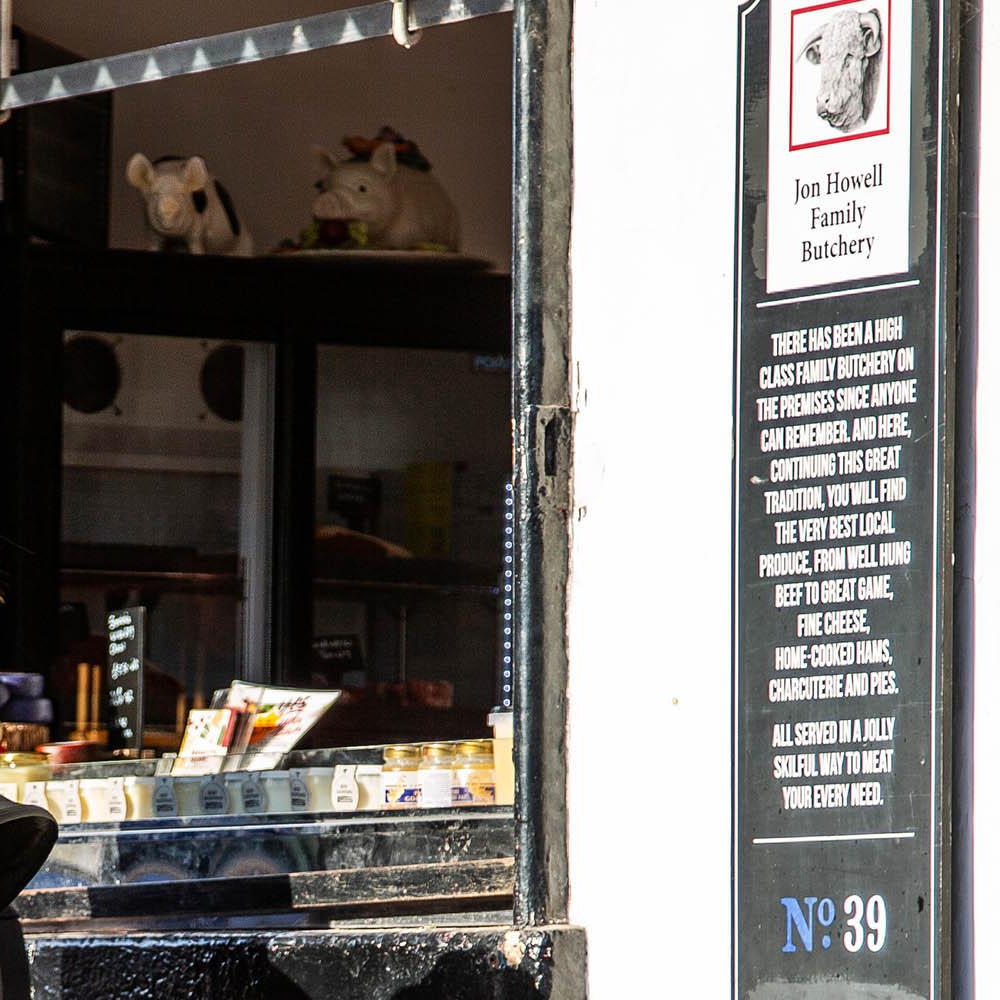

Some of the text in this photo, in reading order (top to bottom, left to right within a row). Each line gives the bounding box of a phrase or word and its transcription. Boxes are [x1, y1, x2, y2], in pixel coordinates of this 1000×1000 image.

[794, 163, 883, 205] Jon Howell
[810, 200, 866, 230] Family
[801, 234, 875, 263] Butchery
[771, 316, 902, 356] THERE HAS BEEN A HIGH
[760, 347, 914, 389] CLASS FAMILY BUTCHERY ON
[757, 380, 917, 421] THE PREMISES SINCE ANYONE
[761, 413, 911, 452] CAN REMEMBER. AND HERE,
[771, 446, 901, 482] CONTINUING THIS GREAT
[764, 486, 825, 514] TRADITION,
[880, 478, 906, 502] FIND
[775, 511, 895, 544] THE VERY BEST LOCAL
[760, 541, 911, 577] PRODUCE, FROM WELL HUNG
[775, 575, 893, 607] BEEF TO GREAT GAME,
[798, 609, 870, 637] FINE CHEESE,
[775, 639, 892, 670] HOME-COOKED HAMS,
[769, 671, 899, 702] CHARCUTERIE AND PIES.
[773, 718, 895, 747] ALL SERVED IN A JOLLY
[774, 750, 893, 778] SKILFUL WAY TO MEAT
[783, 782, 883, 809] YOUR EVERY NEED.
[843, 894, 887, 953] 39
